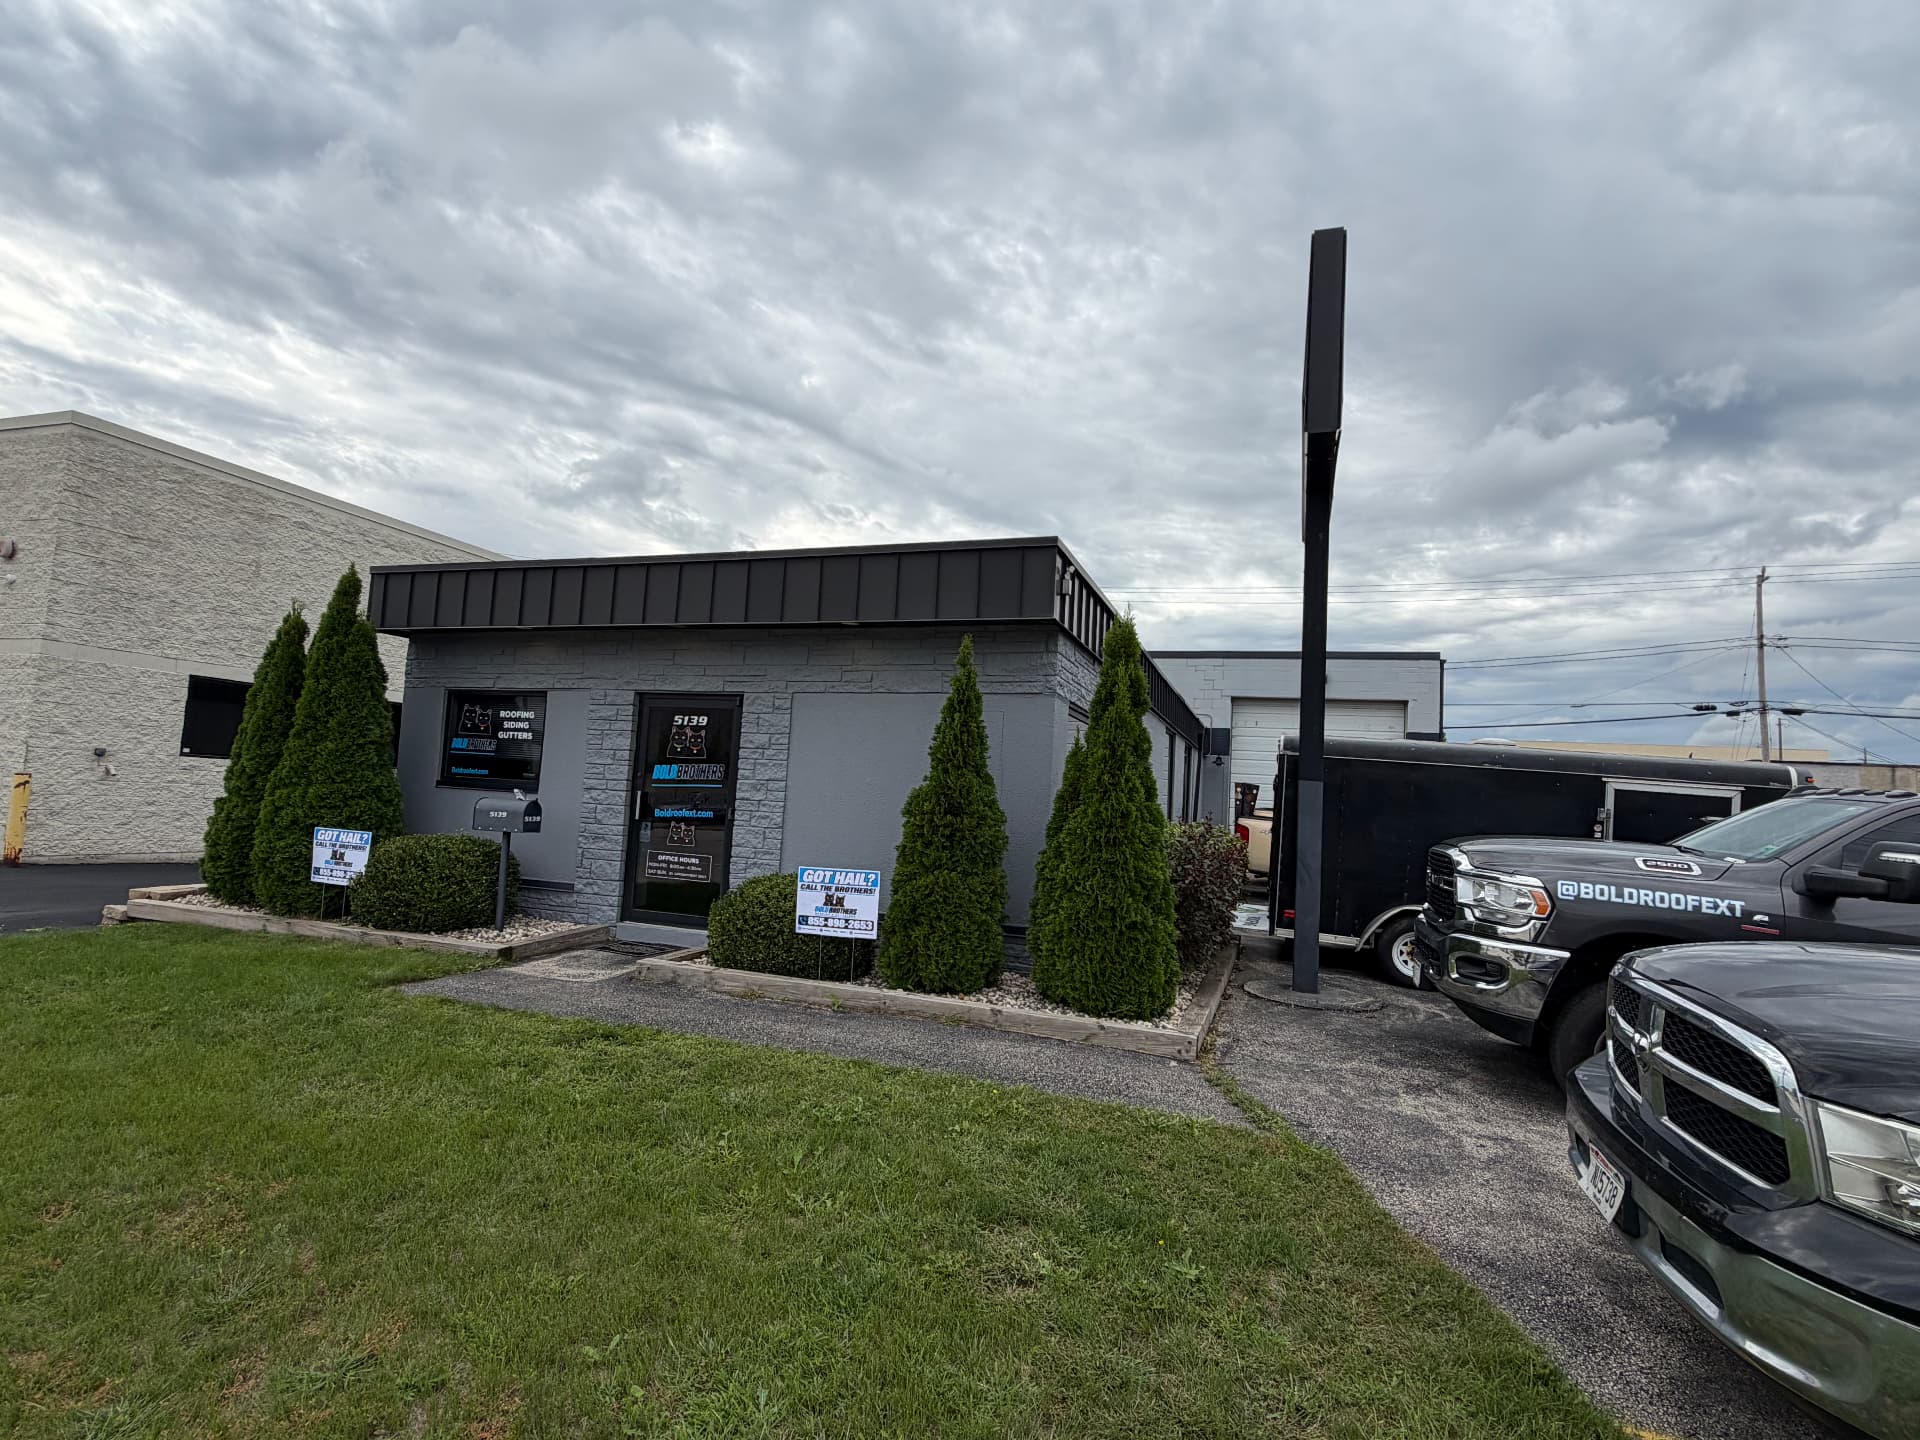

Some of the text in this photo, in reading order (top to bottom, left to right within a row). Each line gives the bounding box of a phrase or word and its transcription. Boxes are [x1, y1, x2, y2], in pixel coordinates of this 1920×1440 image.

[499, 710, 535, 719] ROOFING
[503, 721, 530, 729] SIDING
[673, 715, 708, 726] 5139
[497, 731, 533, 740] GUTTERS
[654, 807, 714, 819] Boldroofext.com
[317, 830, 368, 843] GOT HAIL?
[657, 854, 700, 864] OFFICE HOURS
[1645, 860, 1689, 869] 2500
[803, 869, 876, 887] GOT HAIL?
[834, 886, 876, 895] BROTHERS!
[1557, 880, 1745, 918] @BOLDROOFEXT
[807, 916, 873, 930] 855-898-2653
